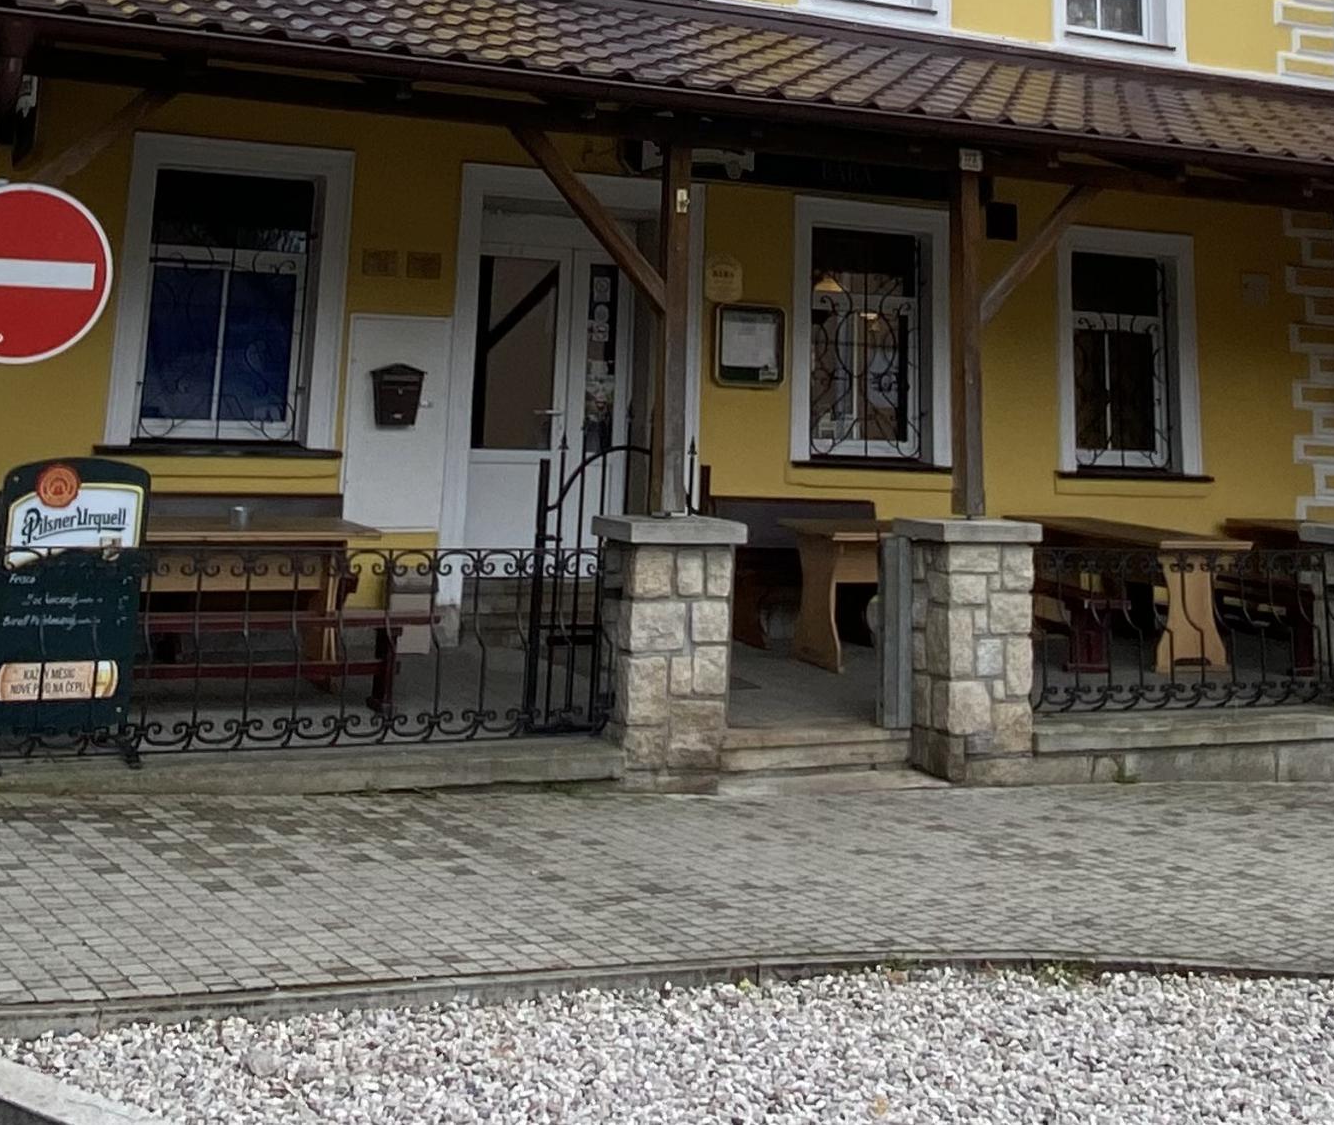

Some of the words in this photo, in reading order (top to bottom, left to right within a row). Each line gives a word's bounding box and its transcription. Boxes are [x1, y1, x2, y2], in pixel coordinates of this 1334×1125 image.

[21, 507, 77, 545] Pilsner
[76, 506, 127, 533] Urquell
[53, 682, 63, 692] NA
